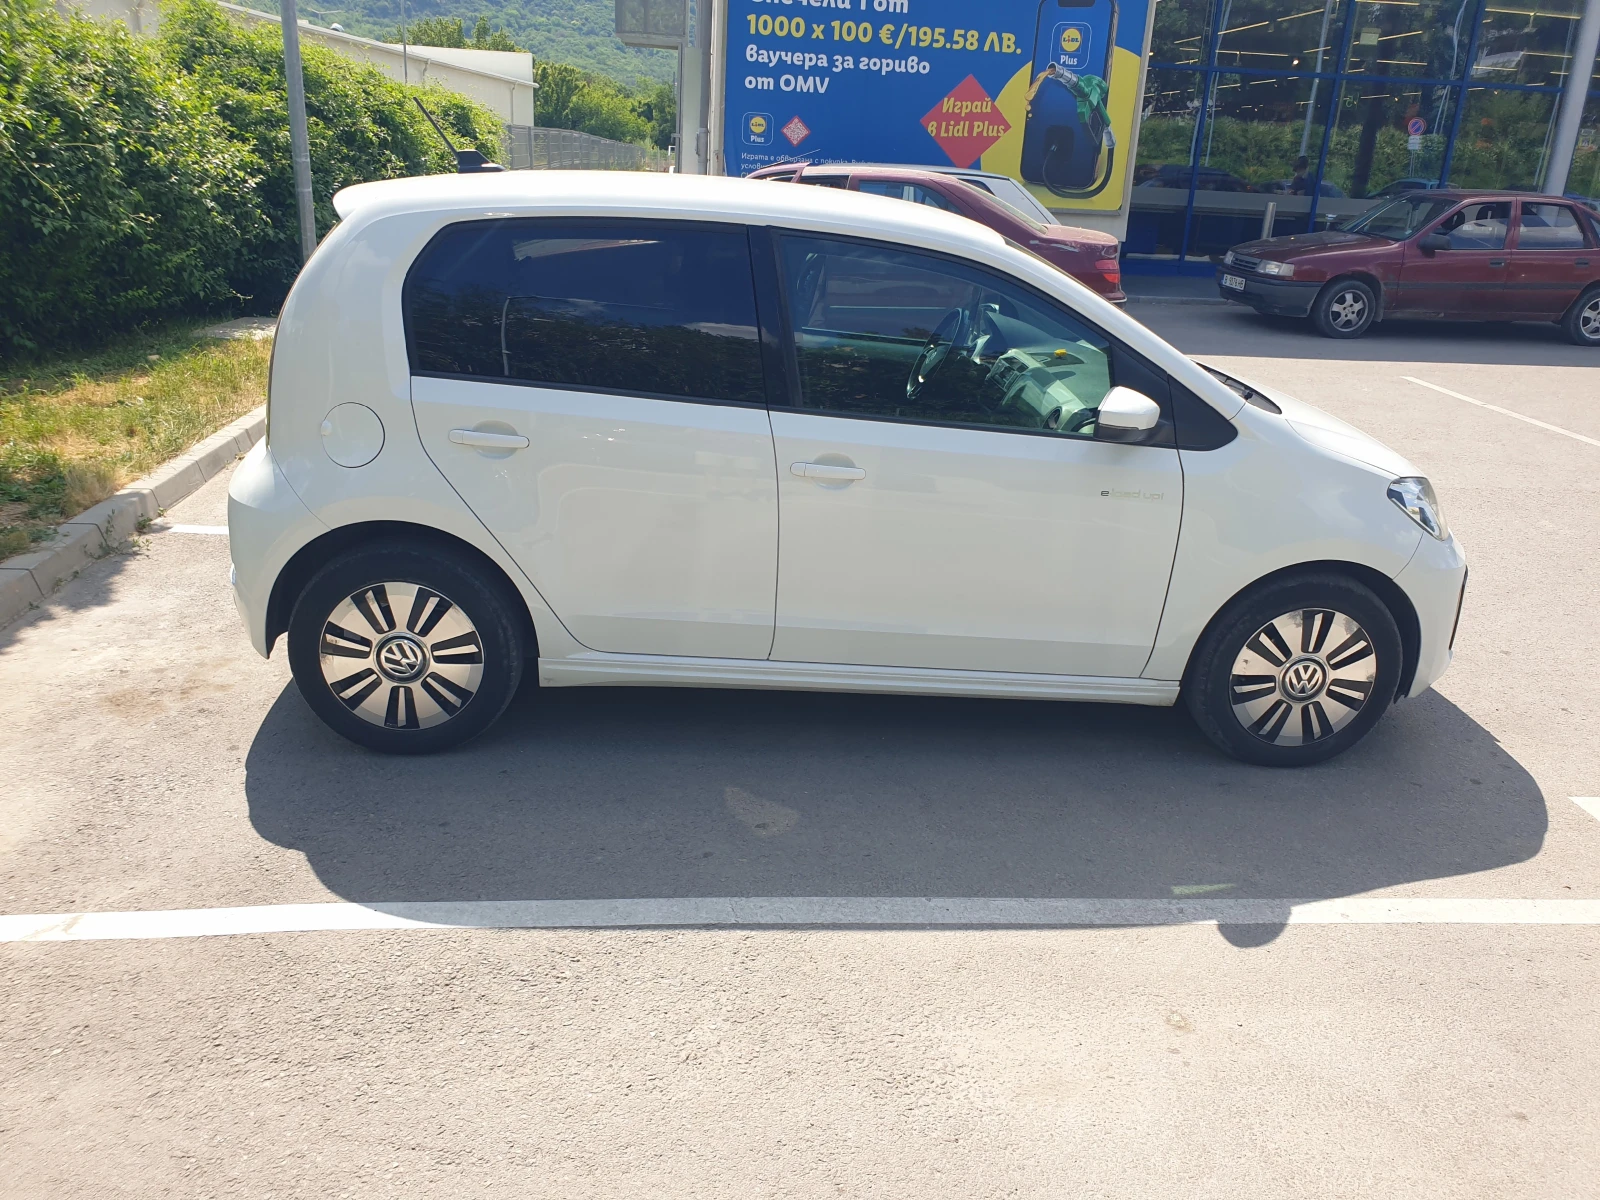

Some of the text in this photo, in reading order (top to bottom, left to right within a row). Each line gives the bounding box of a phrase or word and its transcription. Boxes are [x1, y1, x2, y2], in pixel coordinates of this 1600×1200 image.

[747, 14, 806, 38] 1000
[831, 20, 873, 43] 100
[746, 44, 931, 76] ваучера за гориво
[1060, 55, 1078, 65] Plus
[744, 74, 830, 94] от OMV
[942, 97, 992, 117] Играй
[927, 120, 1005, 137] в Lidl Plus
[750, 135, 765, 143] Plus
[741, 152, 769, 162] Играта
